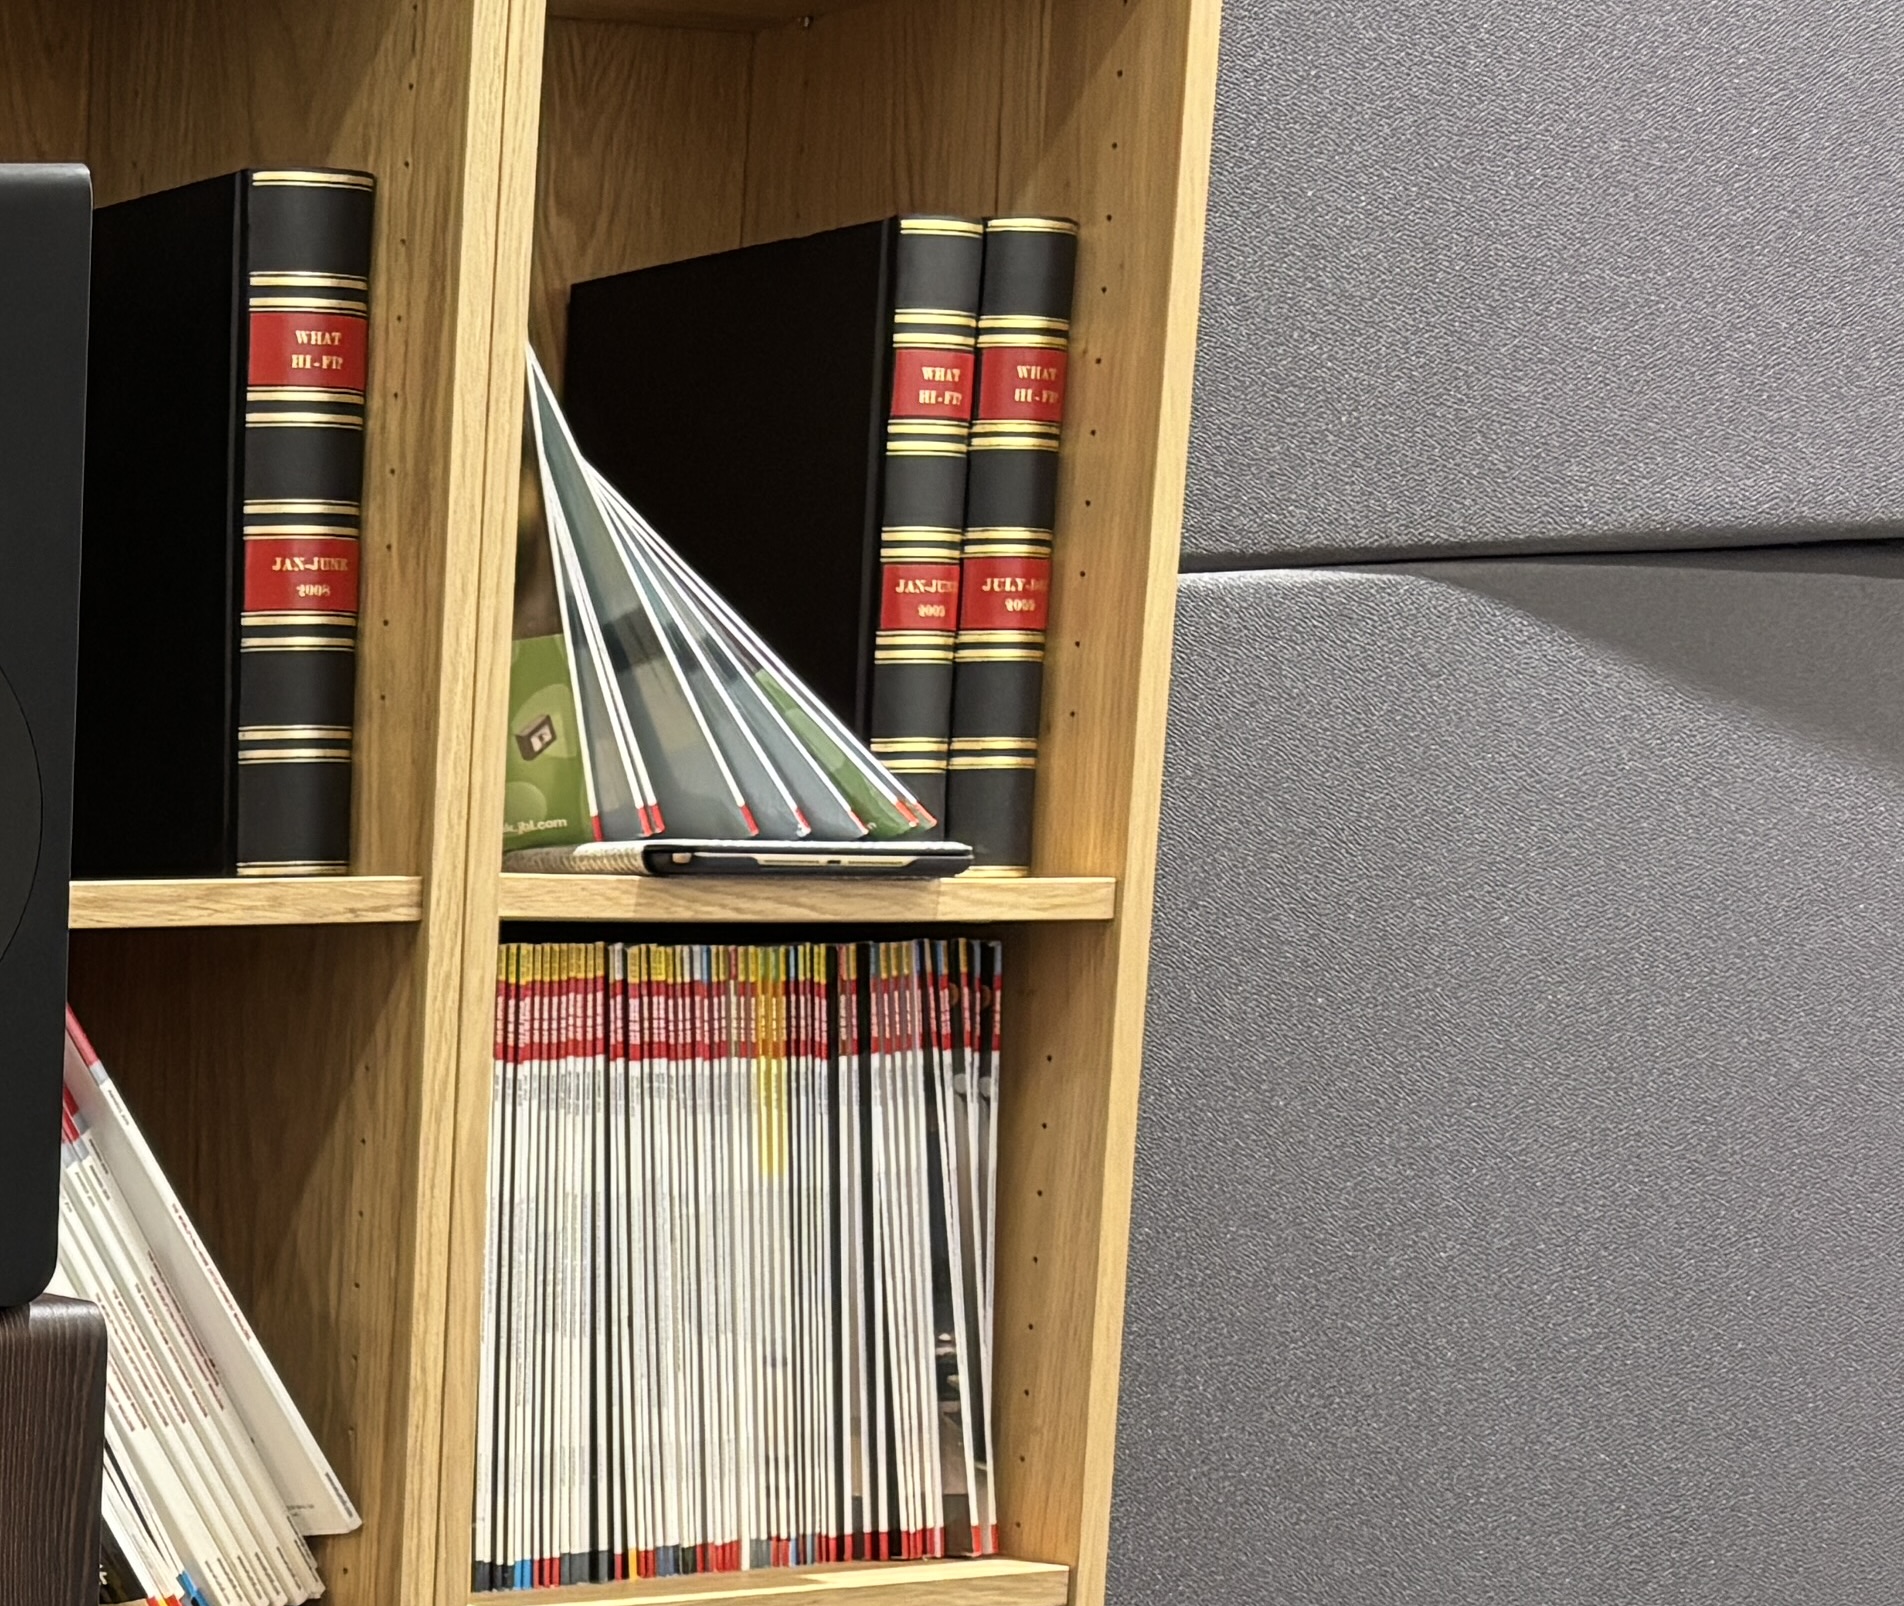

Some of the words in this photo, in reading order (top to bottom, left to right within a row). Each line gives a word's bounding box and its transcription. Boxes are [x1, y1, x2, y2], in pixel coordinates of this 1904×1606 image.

[296, 330, 342, 345] WHAT
[921, 366, 961, 382] WHAT
[1017, 365, 1057, 380] WHAT
